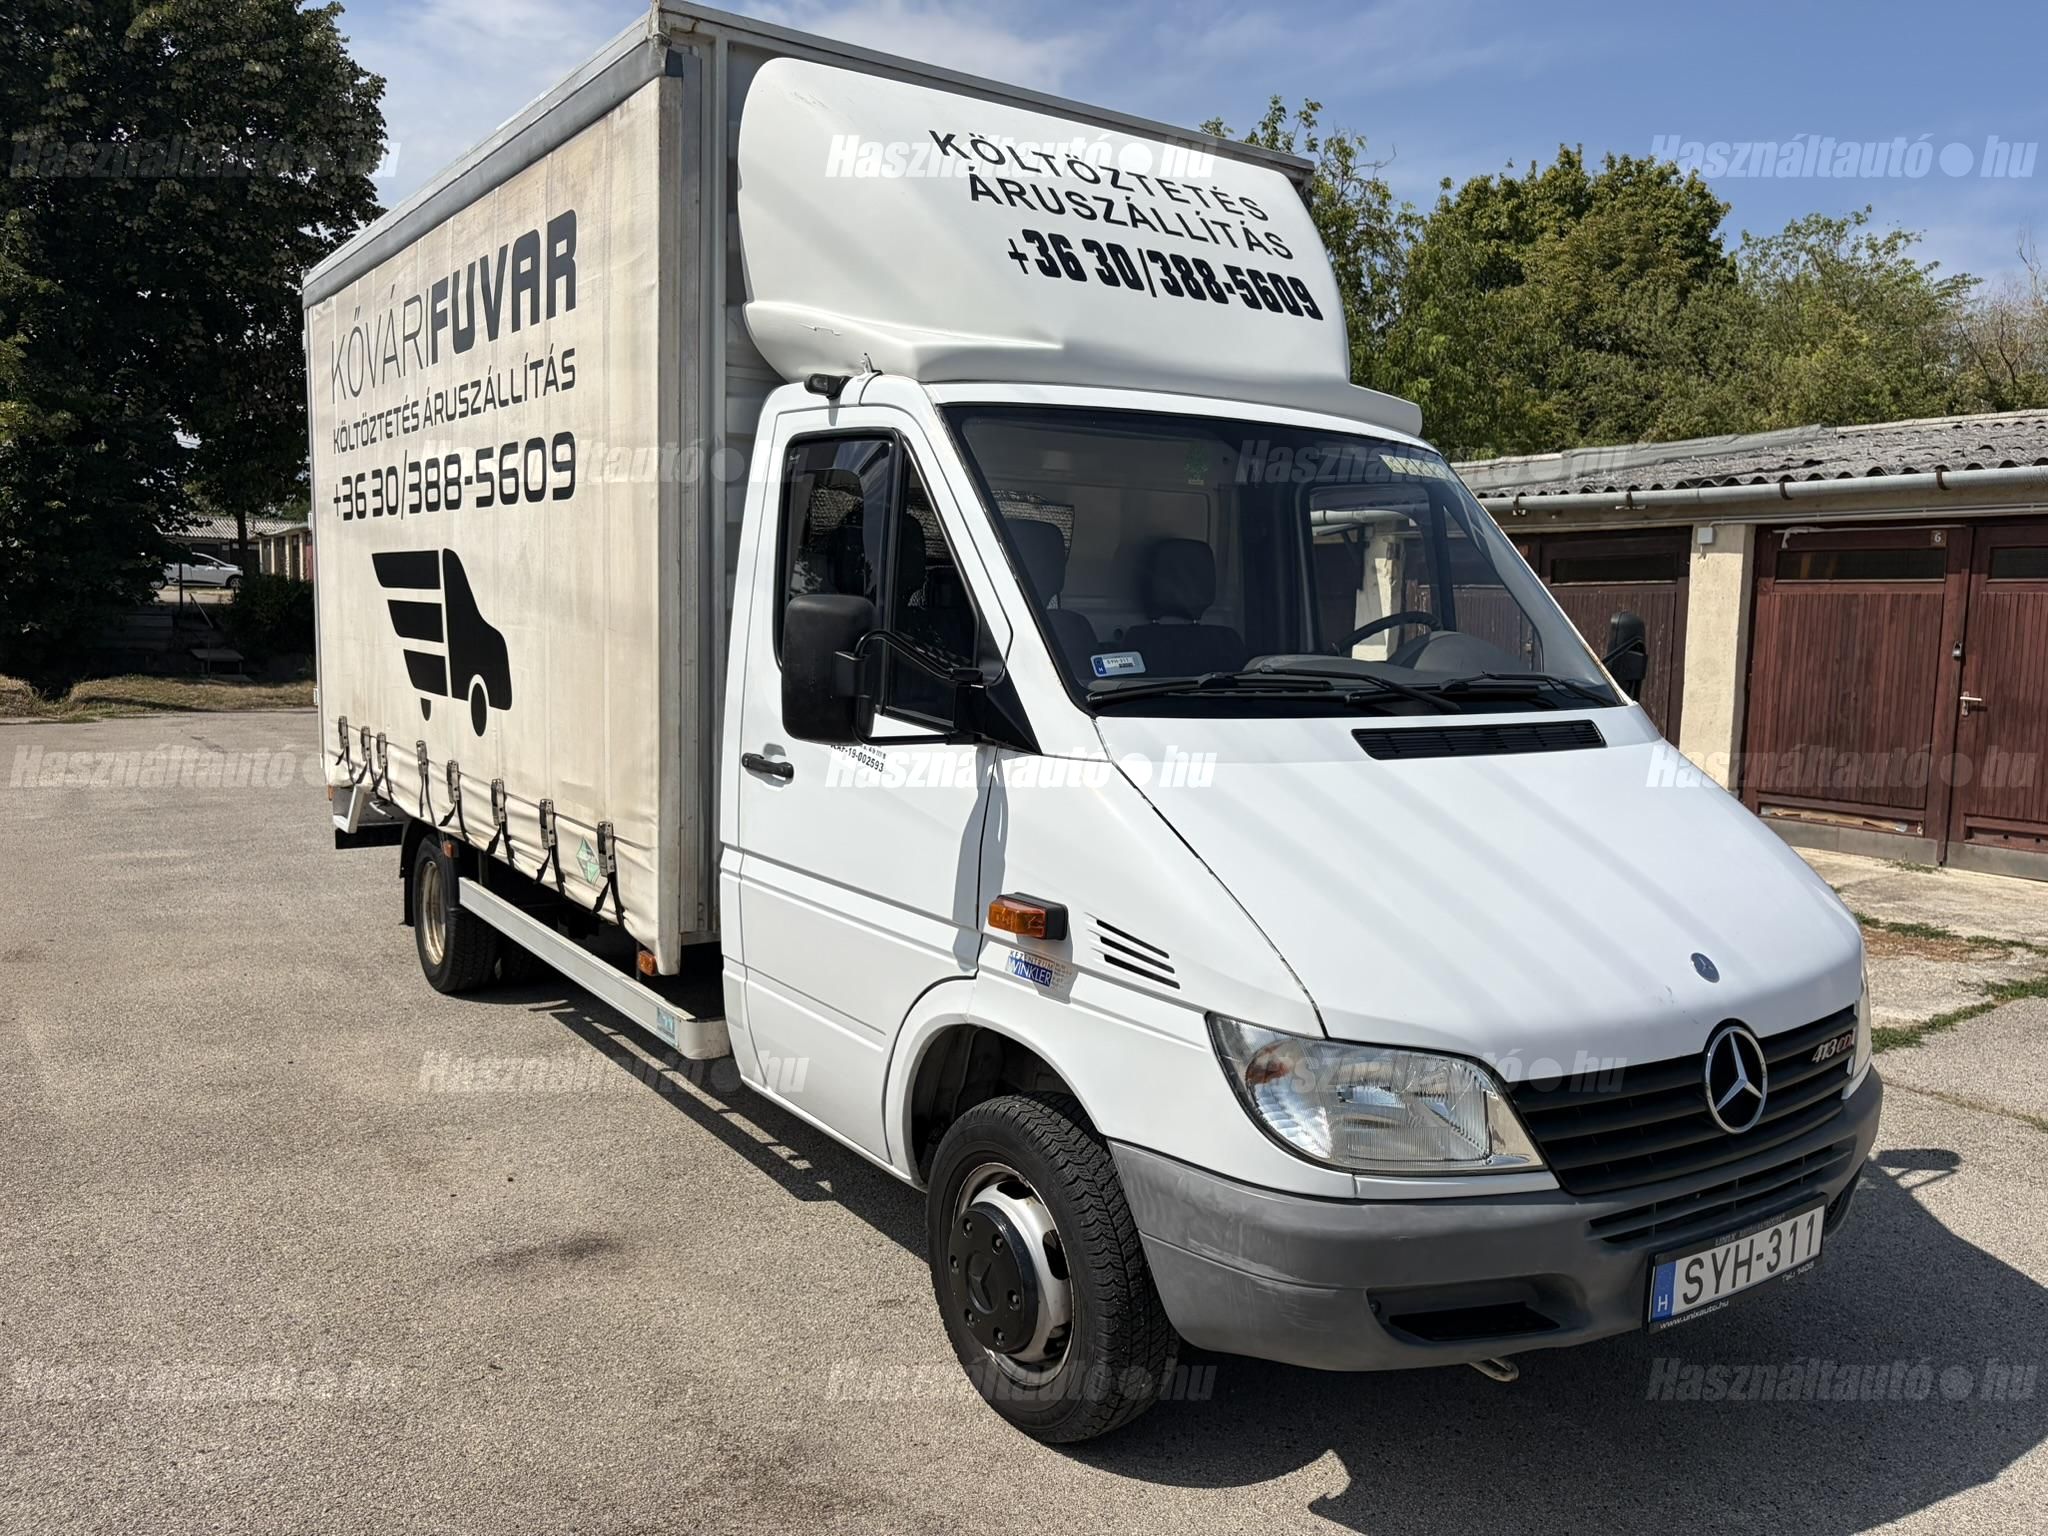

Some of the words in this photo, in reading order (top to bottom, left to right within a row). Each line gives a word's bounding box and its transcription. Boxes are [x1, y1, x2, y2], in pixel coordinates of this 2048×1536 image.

[928, 130, 1269, 221] KÖLTÖZTETÉS
[969, 167, 1294, 260] ÁRUSZÁLLÍTÁS
[333, 394, 419, 454] KÖLTÖZTETÉS
[422, 342, 576, 429] ÁRUSZÁLLÍTÁS
[1934, 531, 1942, 543] 6
[1008, 956, 1052, 986] WINKLER
[1657, 1294, 1669, 1312] H
[1682, 1213, 1816, 1306] SYH-311
